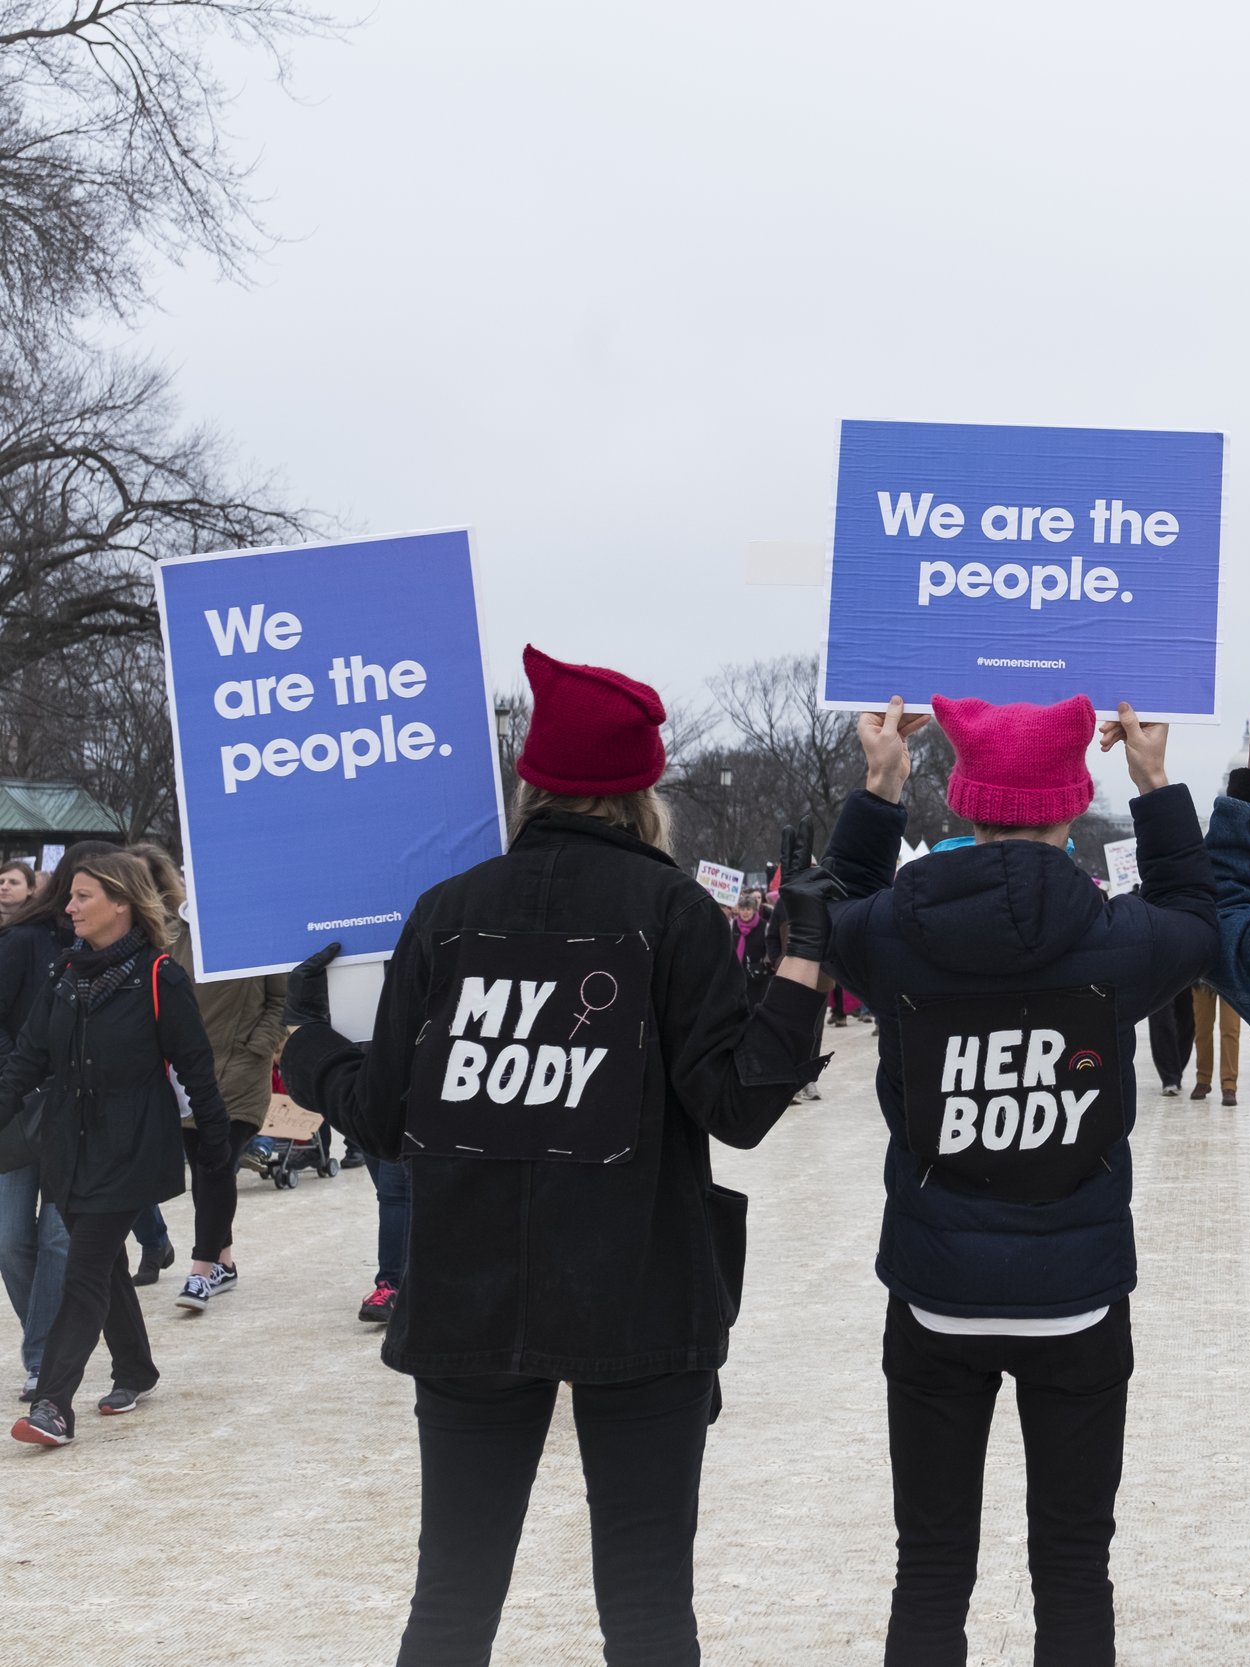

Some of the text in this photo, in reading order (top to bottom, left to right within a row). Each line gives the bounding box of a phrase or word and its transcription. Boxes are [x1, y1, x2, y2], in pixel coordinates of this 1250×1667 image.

[877, 491, 1180, 546] We are the
[918, 557, 1133, 610] people.
[203, 604, 302, 657] We
[213, 655, 427, 720] are the
[977, 656, 1066, 670] #womensmarch
[220, 714, 453, 794] people.
[307, 910, 402, 931] #womensmarch
[449, 977, 557, 1040] MY
[440, 1040, 608, 1109] BODY
[940, 1028, 1067, 1094] HER
[938, 1089, 1100, 1155] BODY
